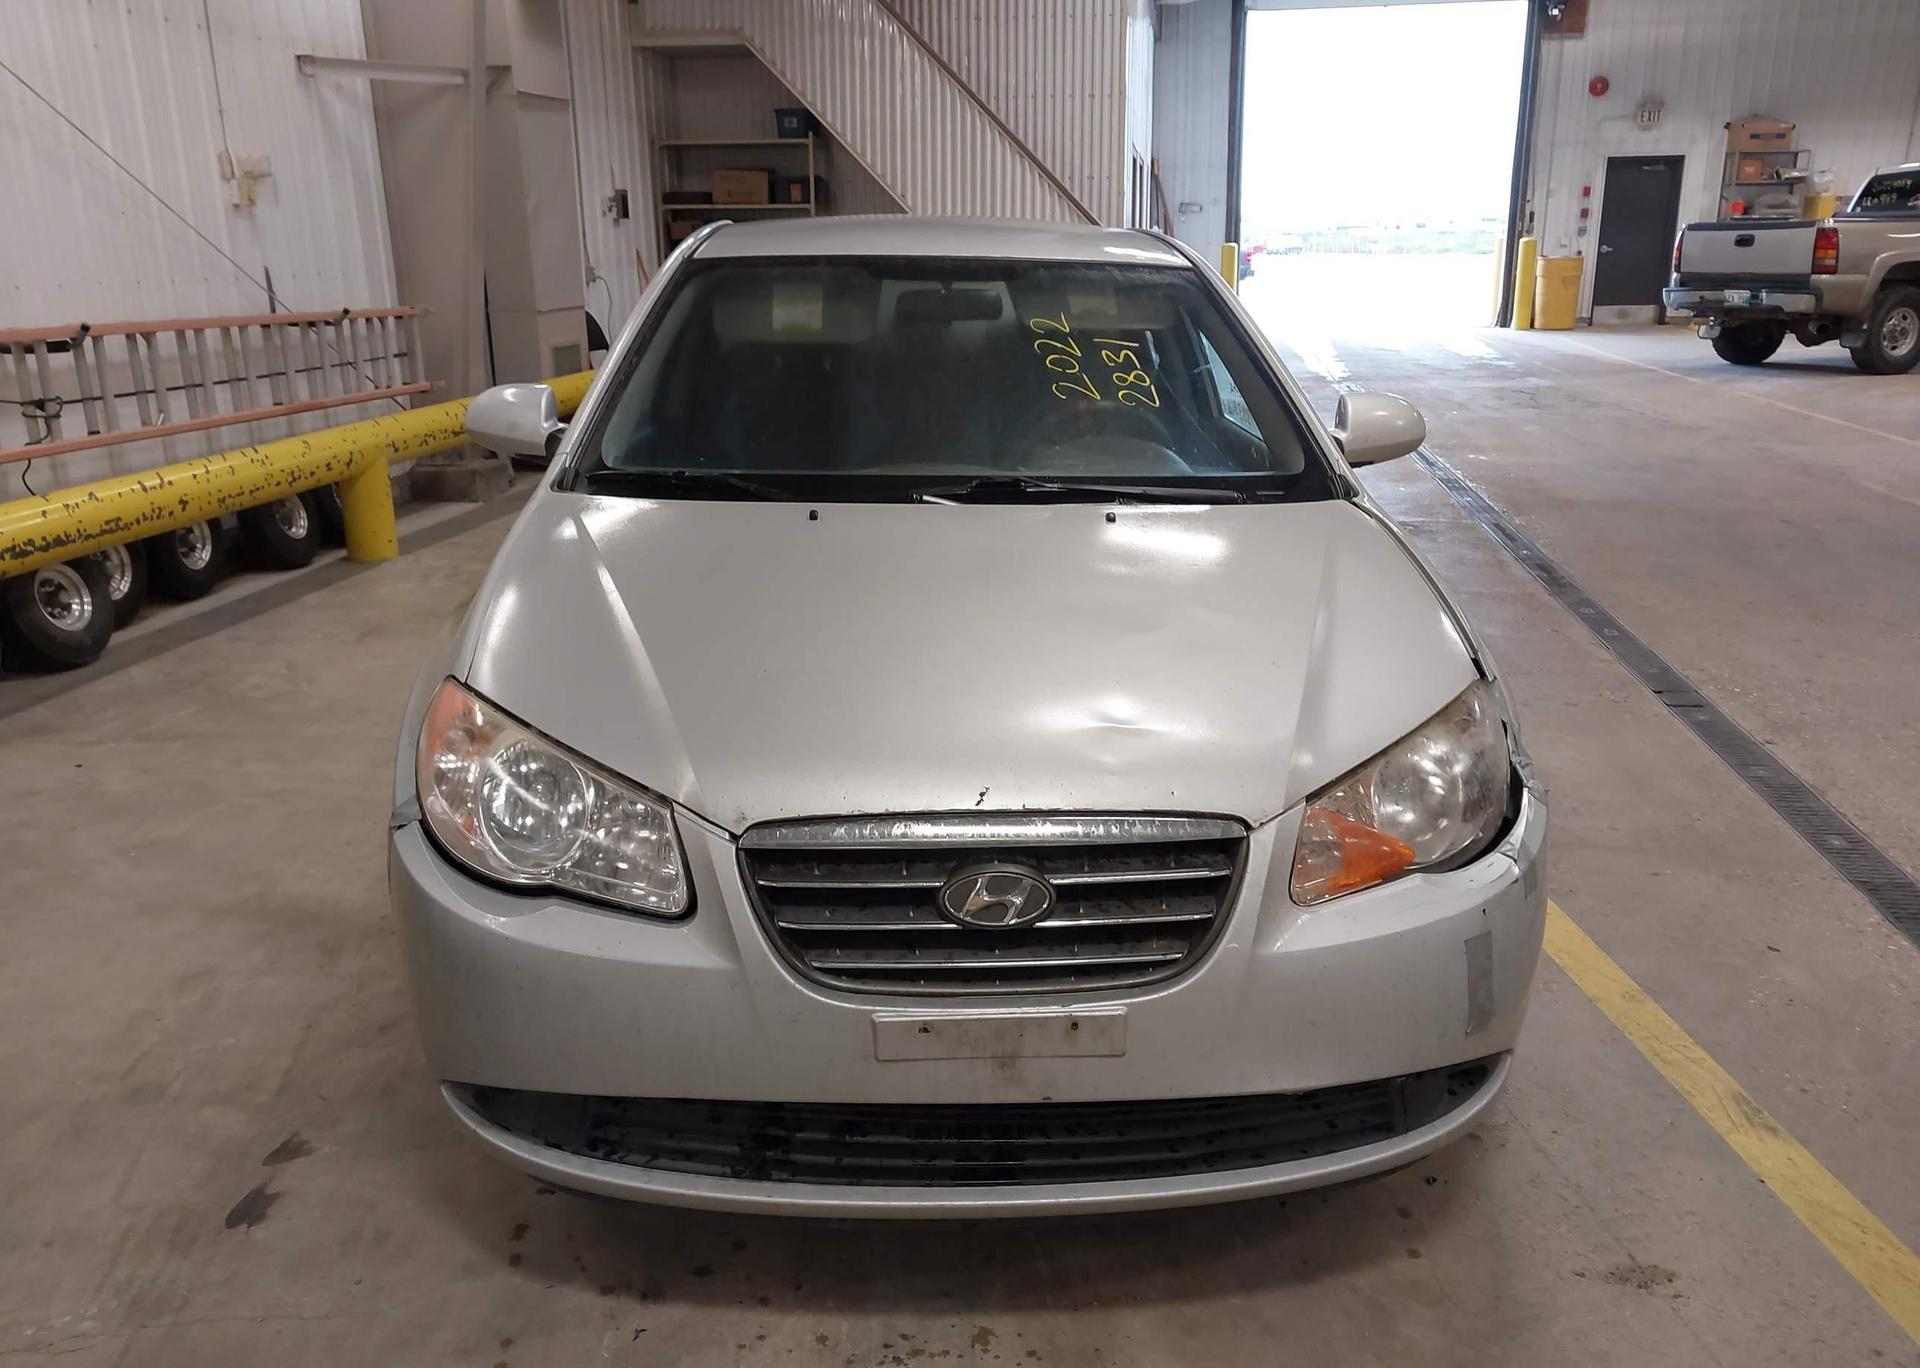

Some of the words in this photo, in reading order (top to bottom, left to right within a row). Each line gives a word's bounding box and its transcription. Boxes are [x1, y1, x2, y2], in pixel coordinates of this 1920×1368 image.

[1640, 110, 1662, 123] EXIT
[1030, 311, 1101, 401] 2022
[1092, 338, 1160, 408] 2831
